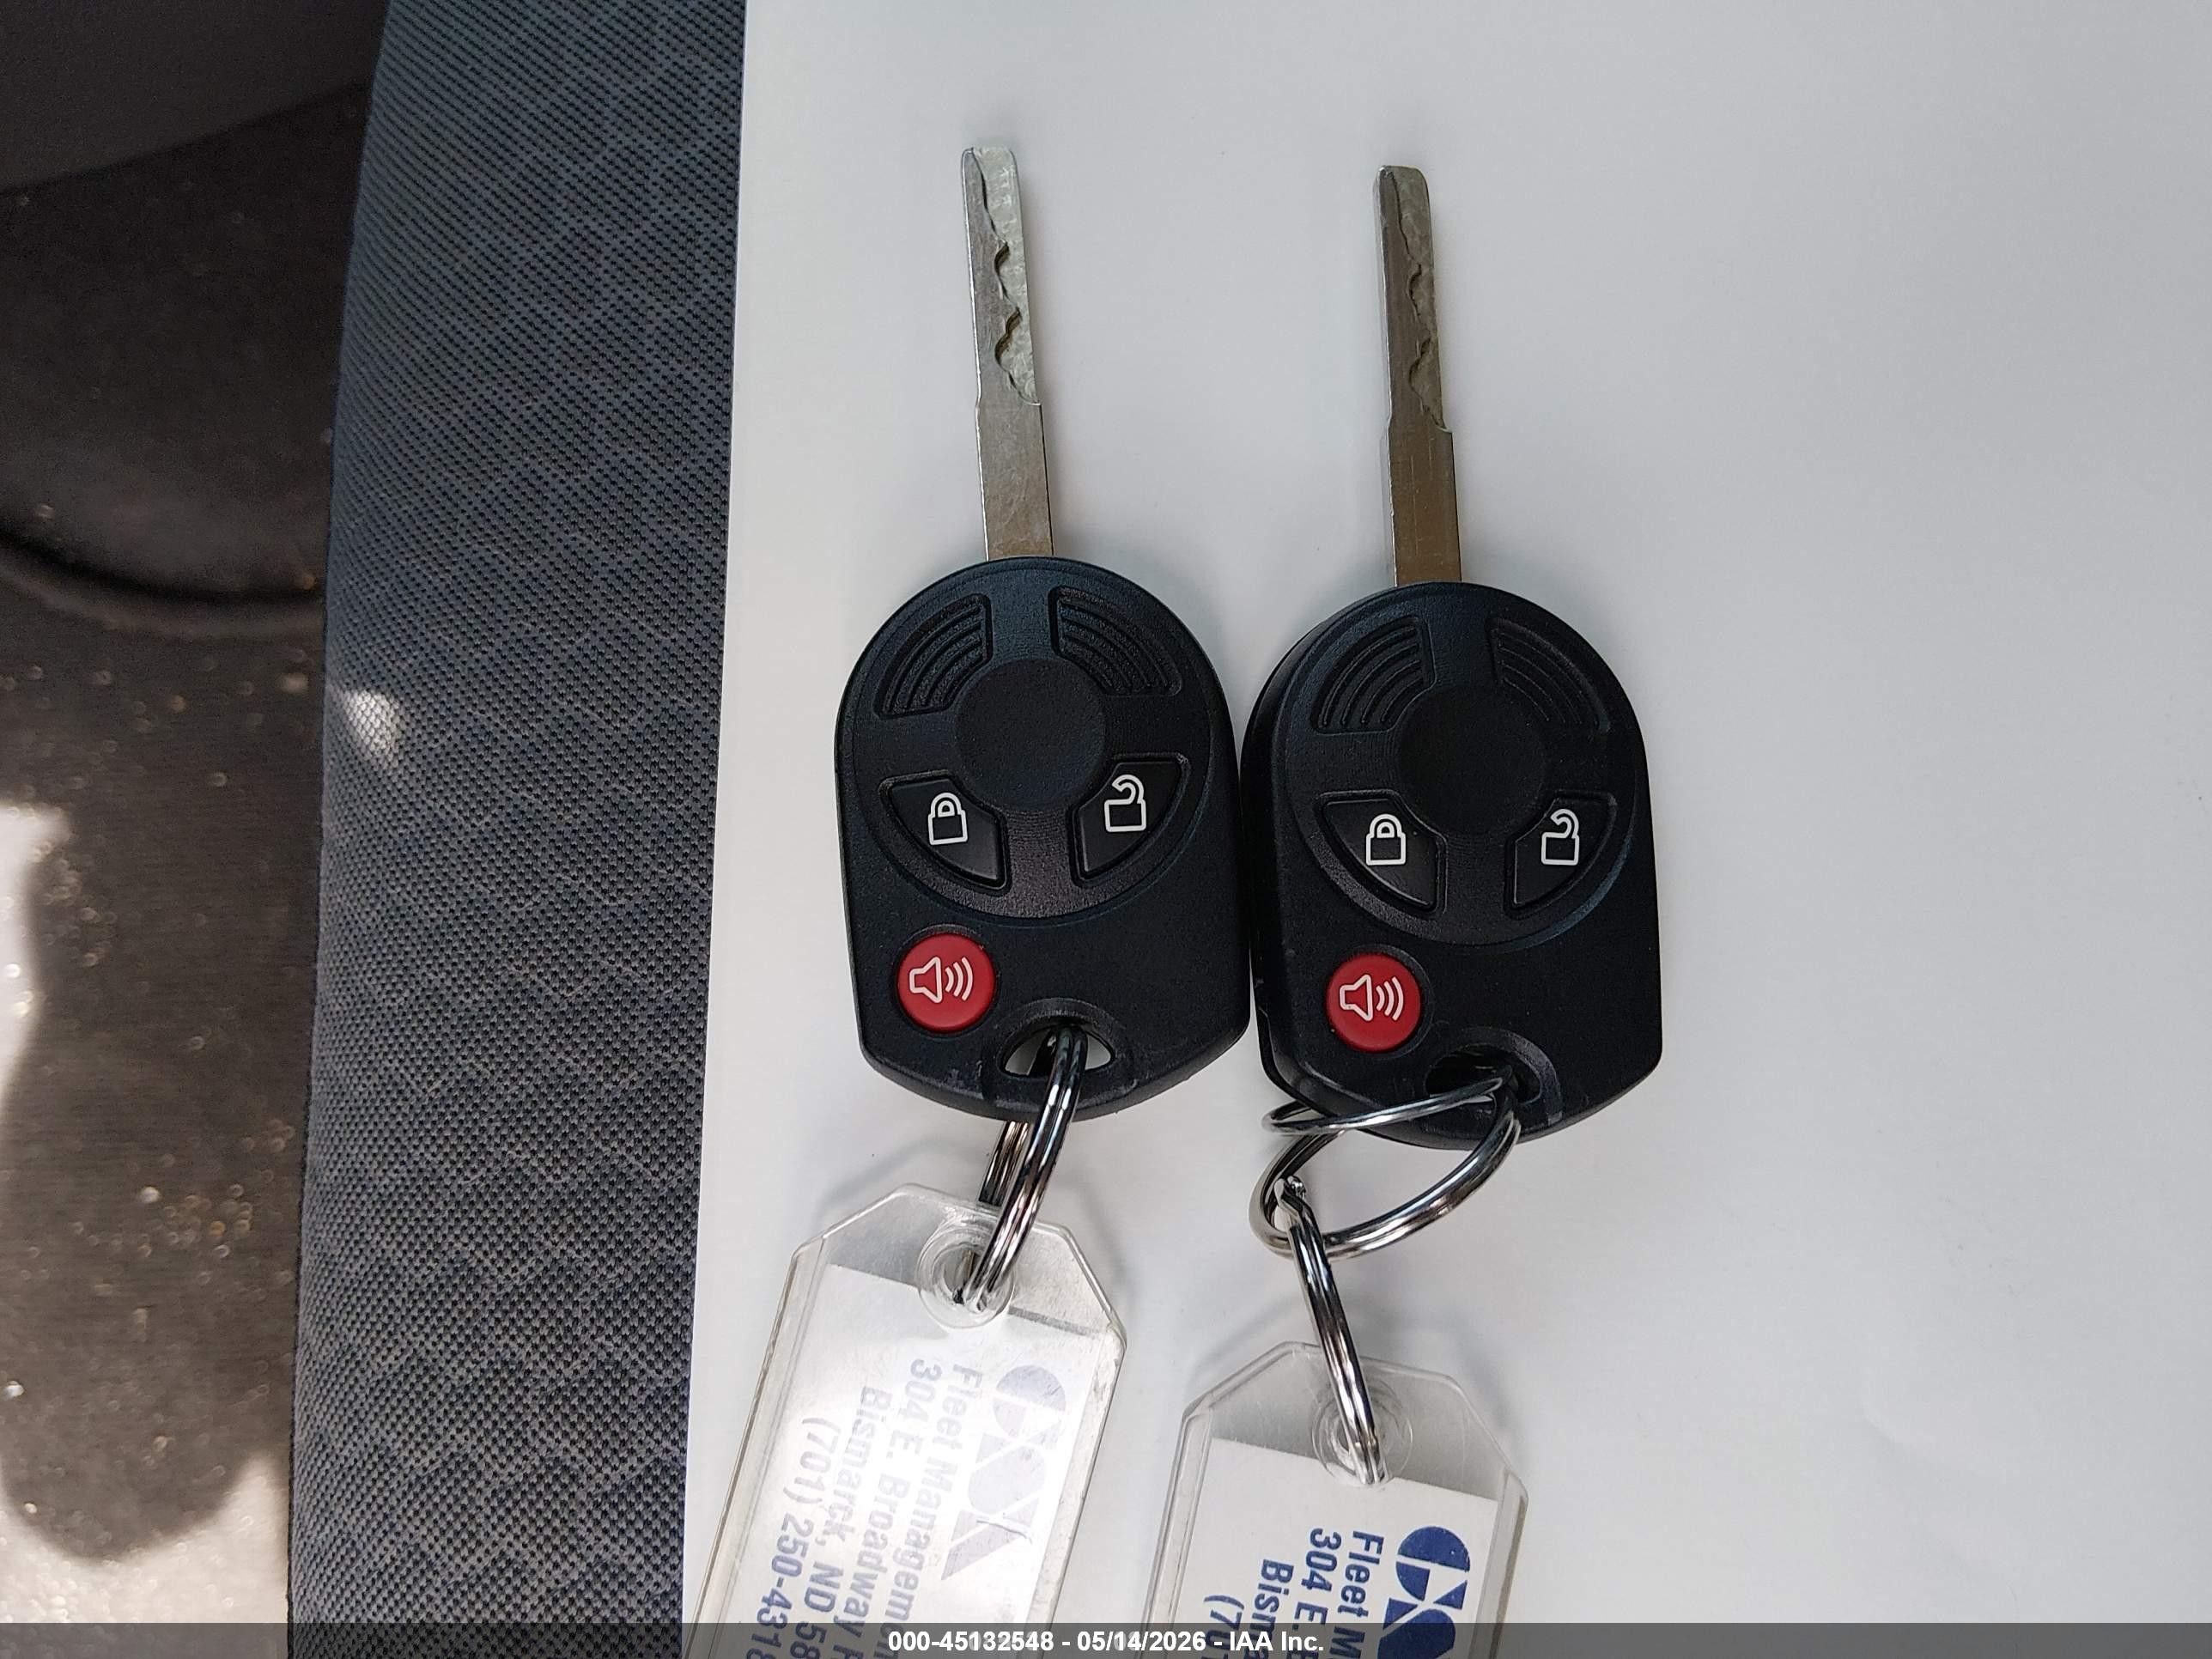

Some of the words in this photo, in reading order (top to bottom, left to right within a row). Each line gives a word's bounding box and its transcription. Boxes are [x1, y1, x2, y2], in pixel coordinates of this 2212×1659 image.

[898, 1358, 943, 1423] 304
[936, 1364, 983, 1450] Fleet
[782, 1417, 842, 1504] (701)
[814, 1385, 894, 1547] Bismarck,
[886, 1429, 925, 1459] E.
[804, 1561, 843, 1613] ND
[834, 1472, 910, 1638] Broadway
[1300, 1528, 1343, 1595] 304
[1336, 1529, 1385, 1618] Fleet
[1291, 1601, 1329, 1631] E.
